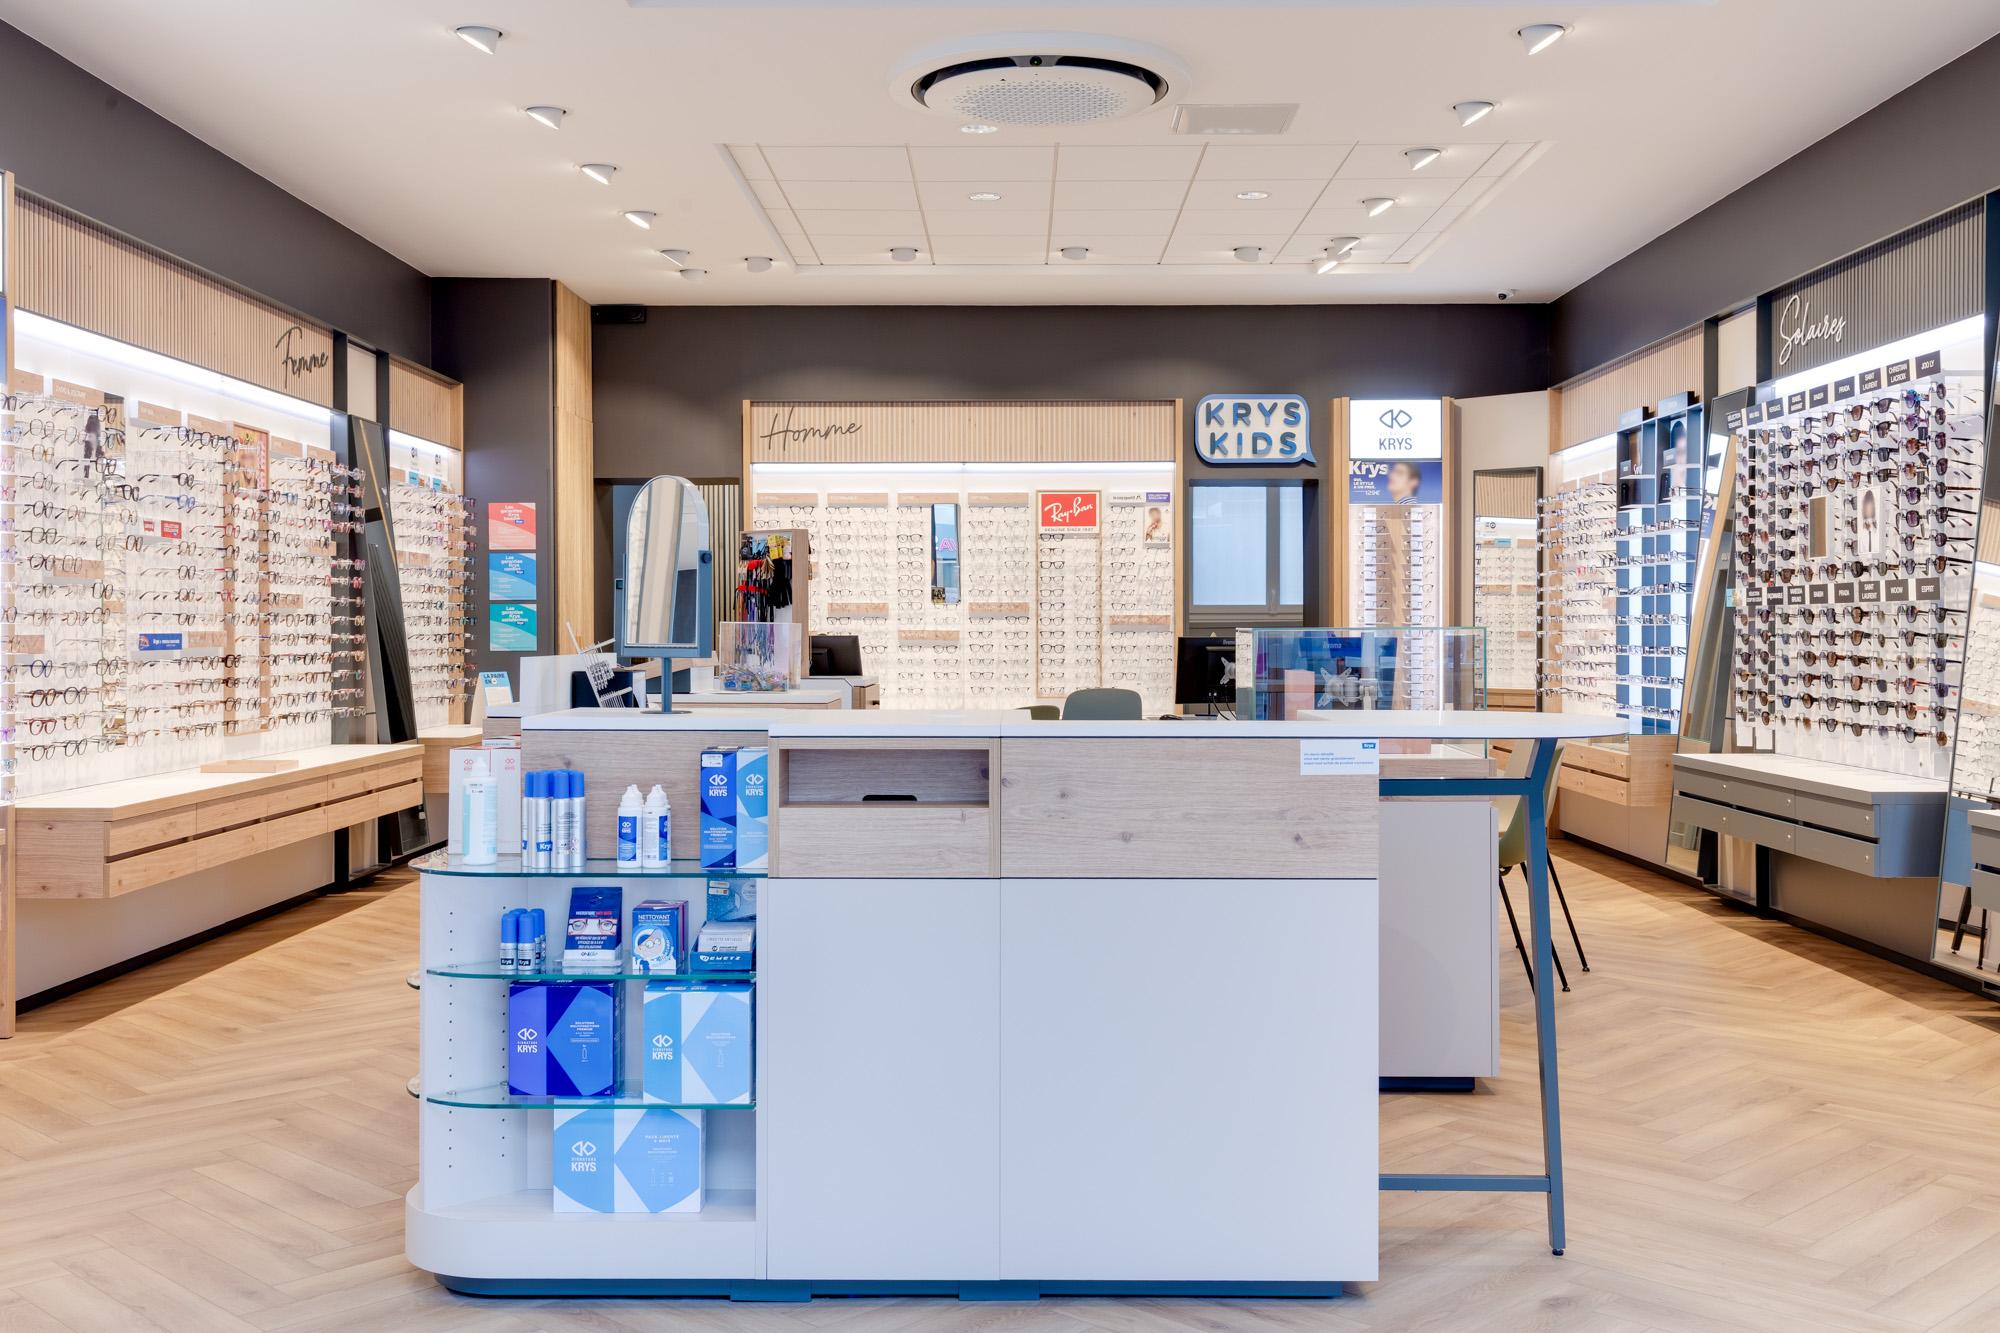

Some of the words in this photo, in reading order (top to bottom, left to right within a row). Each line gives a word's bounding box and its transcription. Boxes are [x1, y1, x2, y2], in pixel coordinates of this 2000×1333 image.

[1780, 294, 1846, 366] Solaires
[275, 325, 328, 390] Femme
[1888, 364, 1908, 374] CHRISTIAN
[1864, 372, 1875, 381] SAINT
[1862, 381, 1878, 391] LAURENT
[1205, 402, 1302, 426] KRYS
[760, 406, 862, 452] Homme
[1210, 432, 1298, 456] KIDS
[1379, 438, 1412, 450] KRYS
[1348, 461, 1389, 478] Krys
[517, 1045, 538, 1053] KRYS
[652, 1052, 673, 1060] KRYS
[571, 1162, 597, 1172] KRYS
